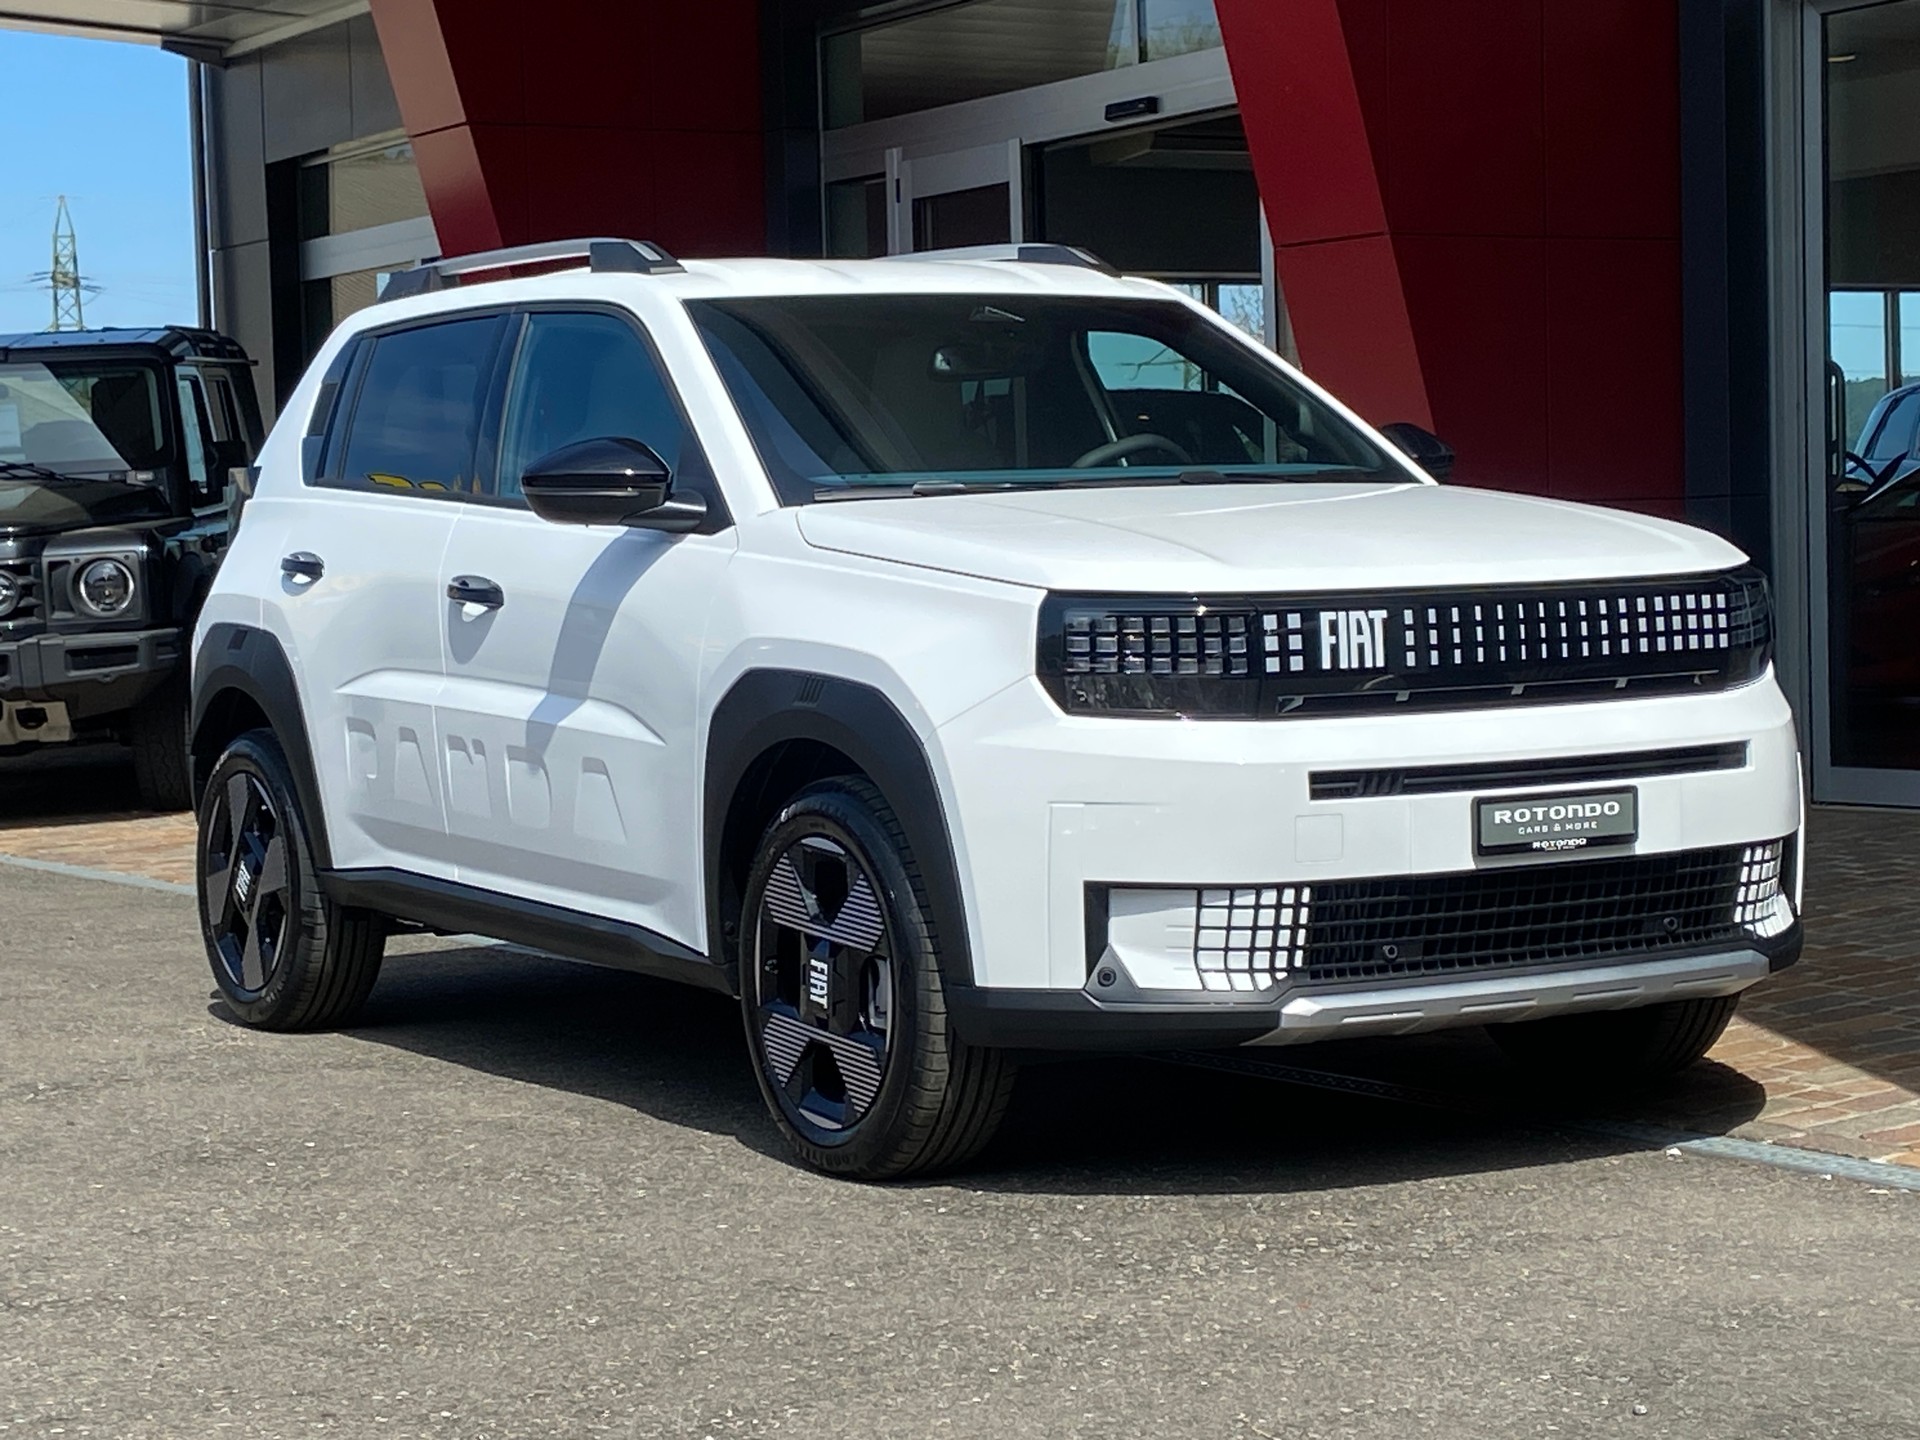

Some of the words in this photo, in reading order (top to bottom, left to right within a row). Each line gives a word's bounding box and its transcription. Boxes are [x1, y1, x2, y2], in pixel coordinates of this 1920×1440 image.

[1320, 610, 1387, 669] FIAT
[1494, 801, 1621, 824] ROTONDO
[1518, 825, 1549, 835] CARS
[1553, 823, 1562, 832] &
[1565, 821, 1598, 831] MORE
[810, 959, 828, 1009] FIAT
